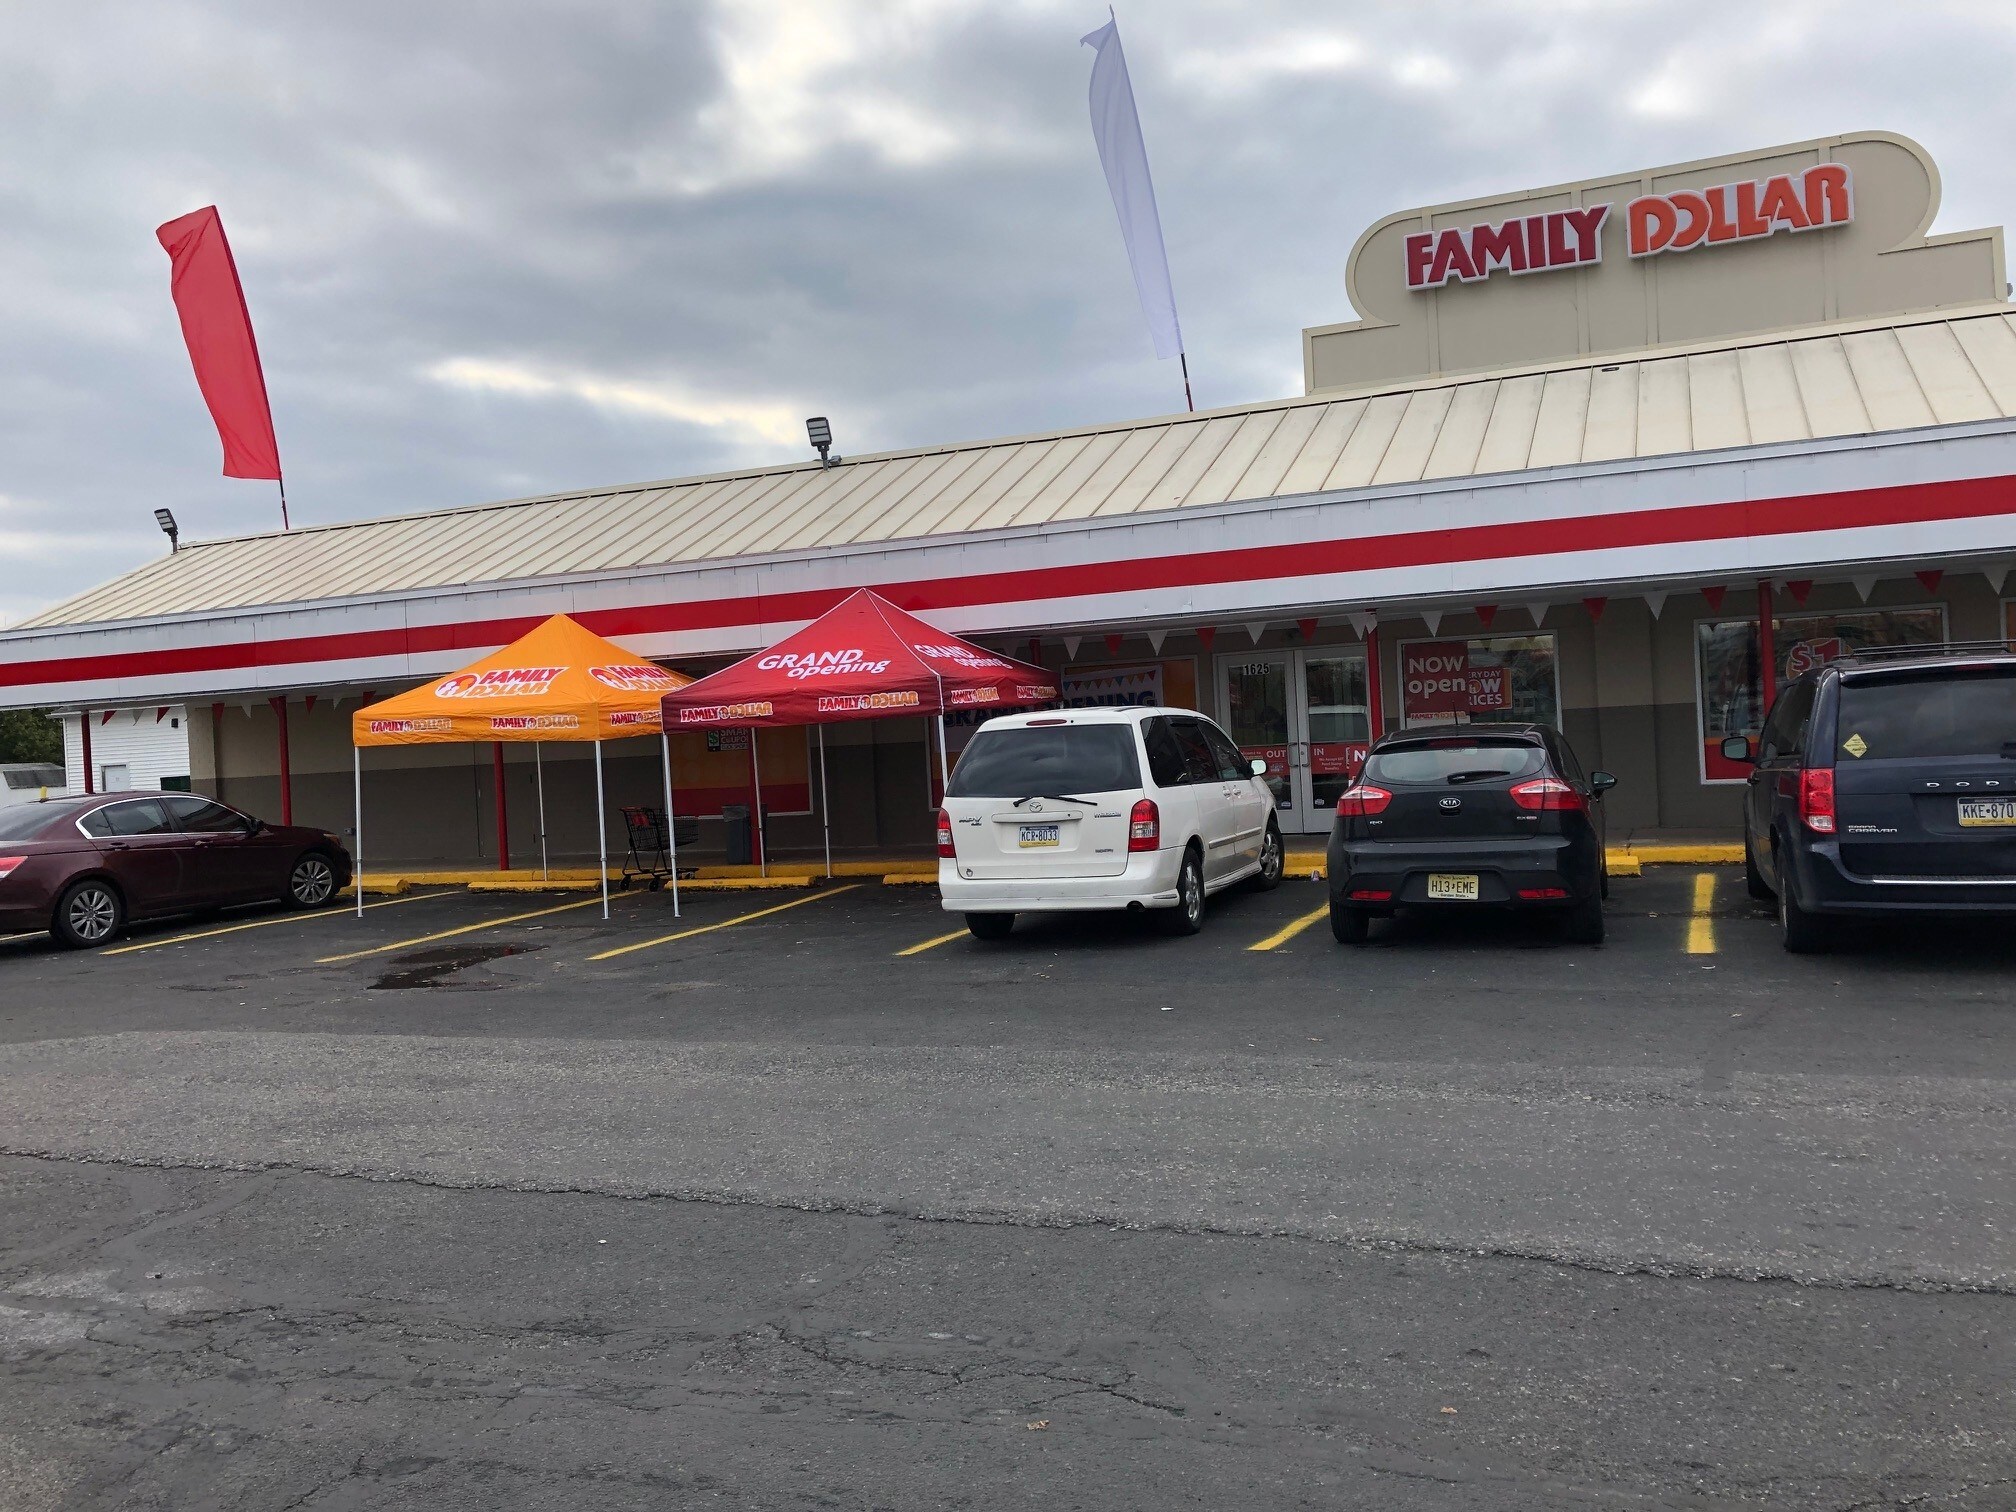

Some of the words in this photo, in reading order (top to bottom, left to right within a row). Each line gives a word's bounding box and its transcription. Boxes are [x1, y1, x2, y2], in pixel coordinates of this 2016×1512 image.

[1405, 204, 1612, 288] FAMILY
[1628, 164, 1852, 256] DOLLAR
[914, 644, 976, 658] GRAND
[1790, 637, 1842, 672] $1
[758, 649, 863, 670] GRAND
[1408, 655, 1465, 674] NOW
[480, 667, 567, 683] FAMILY
[608, 666, 670, 678] FAMILY
[787, 659, 891, 679] opening
[1244, 663, 1270, 675] 1625
[468, 680, 550, 696] DOLLAR
[1408, 678, 1466, 699] open
[1468, 678, 1502, 694] OW
[819, 695, 861, 711] FAMILY
[870, 691, 919, 708] DOLLAR
[610, 712, 637, 726] FAMILY
[680, 706, 720, 722] FAMILY
[729, 702, 773, 718] DOLLAR
[371, 719, 404, 732] FAMILY
[491, 717, 528, 729] FAMILY
[1266, 749, 1287, 758] OUT
[1313, 748, 1324, 756] IN
